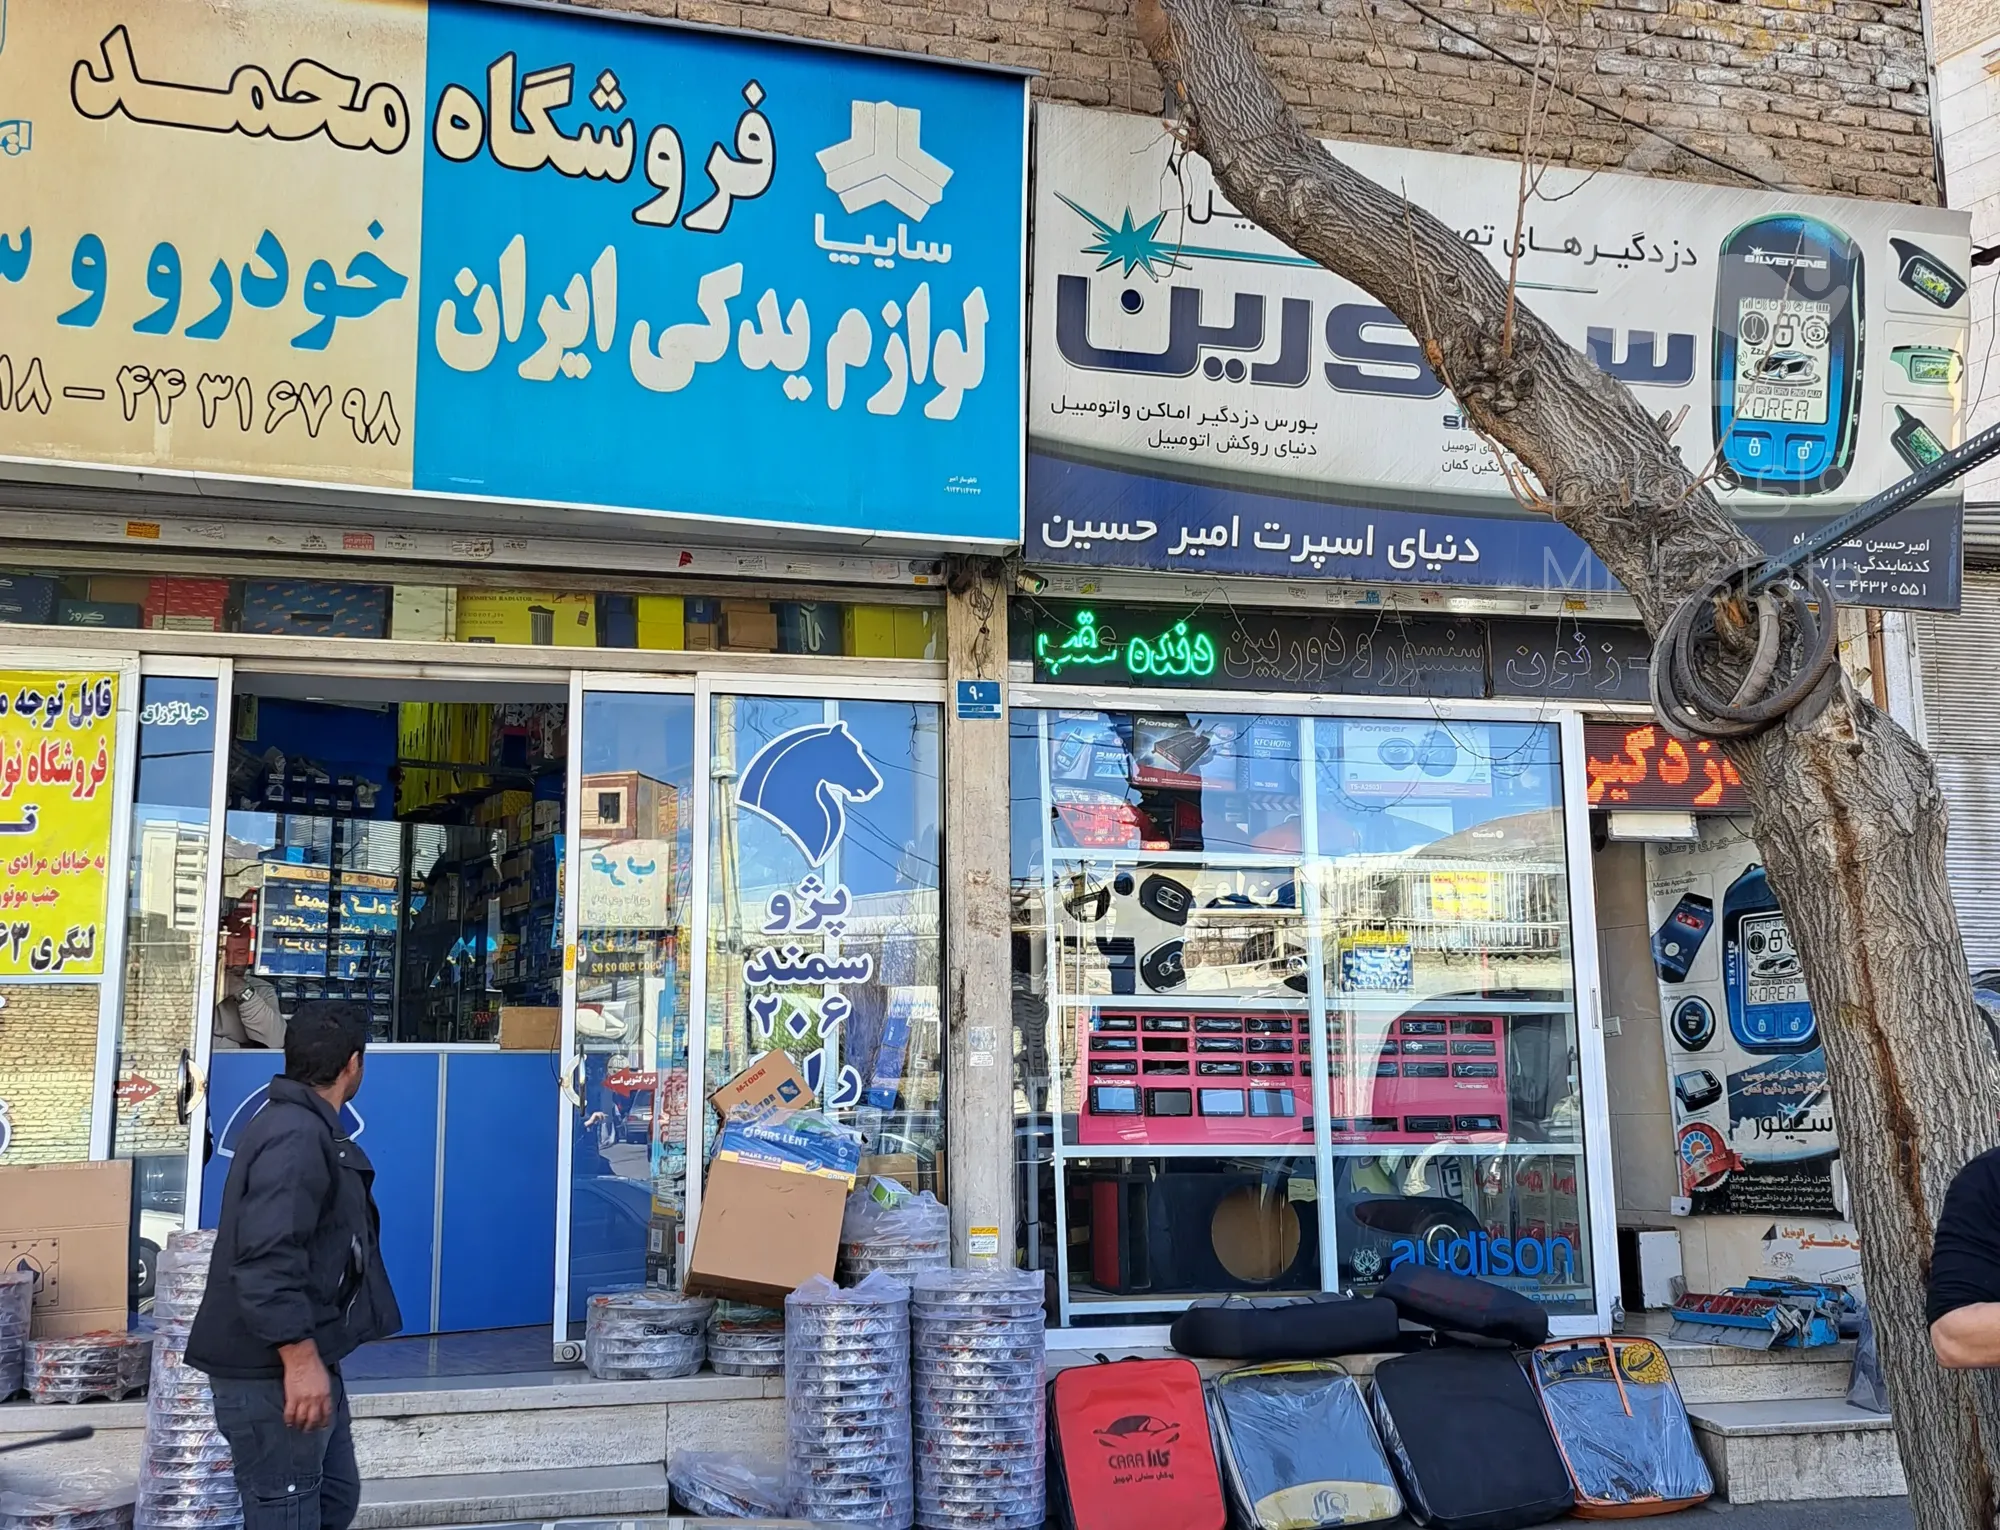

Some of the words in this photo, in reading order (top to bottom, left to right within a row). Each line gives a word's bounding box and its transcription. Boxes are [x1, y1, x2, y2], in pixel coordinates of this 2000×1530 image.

[71, 24, 409, 153] محمد
[432, 50, 776, 233] فروشگاه
[814, 212, 952, 268] سایپا
[56, 232, 107, 328] و
[133, 219, 409, 350] خودرو
[435, 234, 618, 381] ایران
[630, 262, 813, 401] یدکی
[826, 281, 989, 420] لوازم
[1137, 403, 1190, 420] اماکن
[1197, 405, 1259, 428] دزدگیر
[1264, 417, 1318, 435] بورس
[1148, 430, 1210, 449] اتومبیل
[1216, 435, 1268, 456] روکش
[1274, 440, 1318, 459] دنیای
[1441, 440, 1477, 453] اتومبیل
[1441, 459, 1469, 473] کمان
[1042, 513, 1158, 550] حسین
[1168, 515, 1239, 557] امیر
[1253, 520, 1375, 569] اسپرت
[1388, 529, 1480, 571] دنیای
[1224, 627, 1346, 681] دوربین
[1378, 629, 1485, 686] سنسور
[14, 682, 65, 728] توجه
[69, 676, 112, 730] قابل
[1136, 717, 1180, 729] Pioneer
[27, 736, 107, 799] فروشگاه
[8, 851, 47, 876] مرادی
[51, 852, 90, 876] خیابان
[31, 888, 60, 908] جنب
[763, 874, 853, 937] پژو
[30, 923, 95, 971] لنگری
[742, 944, 873, 986] سمند
[1726, 940, 1737, 987] SILVER
[1749, 985, 1797, 1002] KOREA
[749, 993, 852, 1040] ۲۰۶
[137, 1084, 153, 1095] درب
[623, 1075, 642, 1086] کشویی
[642, 1075, 656, 1085] درب
[735, 1068, 767, 1093] M-TOOSI
[783, 1132, 810, 1147] LENT
[1790, 1173, 1811, 1184] دزدگیر
[1812, 1175, 1831, 1184] کنترل
[1391, 1231, 1574, 1277] audison
[1108, 1453, 1146, 1469] CARA
